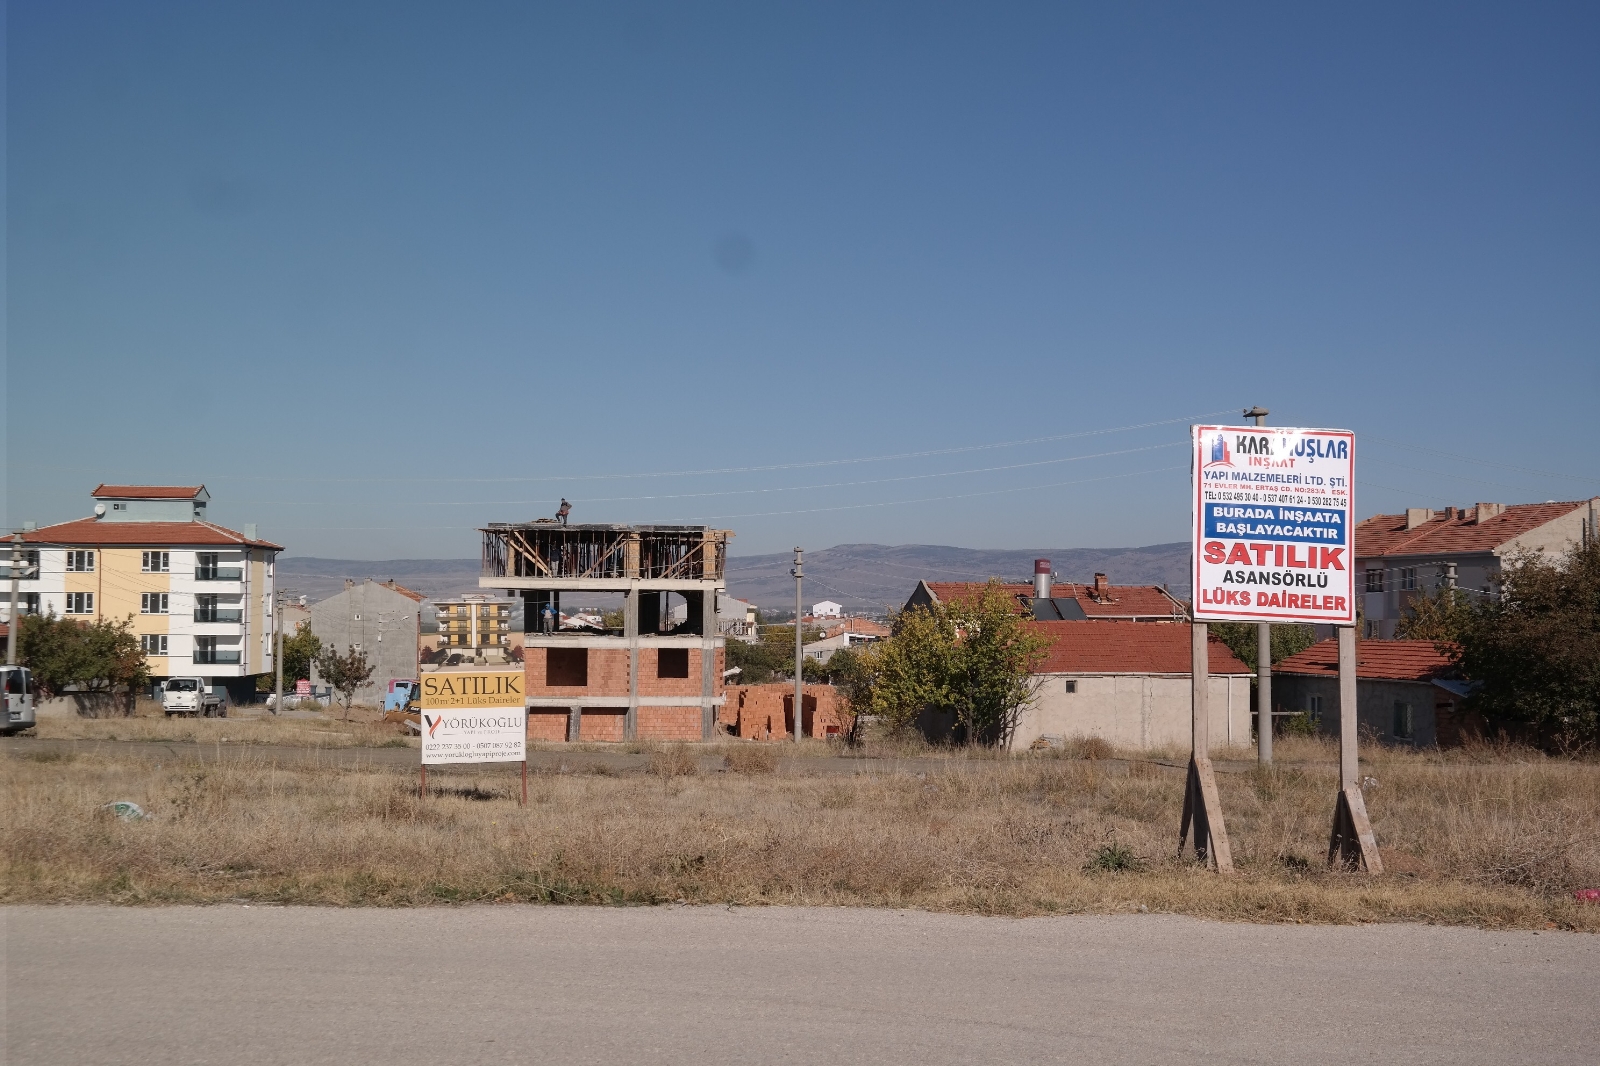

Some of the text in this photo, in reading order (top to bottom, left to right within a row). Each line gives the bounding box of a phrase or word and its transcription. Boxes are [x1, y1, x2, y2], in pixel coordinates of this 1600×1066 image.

[1204, 471, 1348, 488] YAPI MALZEMELERİ LTD. ŞTİ.
[1205, 491, 1216, 500] TEL:
[1218, 492, 1221, 500] 0
[1223, 492, 1232, 500] 532
[1245, 493, 1251, 501] 30
[1263, 494, 1266, 502] 0
[1268, 494, 1277, 502] 537
[1312, 497, 1321, 505] 530
[1213, 506, 1342, 524] BURADA İNŞAATA
[1216, 523, 1338, 539] BAŞLAYACAKTIR
[1204, 541, 1345, 571] SATILIK
[1223, 570, 1328, 588] ASANSÖRLÜ
[1203, 587, 1346, 611] LÜKS DAİRELER
[425, 676, 521, 696] SATILIK
[488, 696, 520, 704] Daireler
[443, 716, 522, 729] YÖRÜKOĞLU
